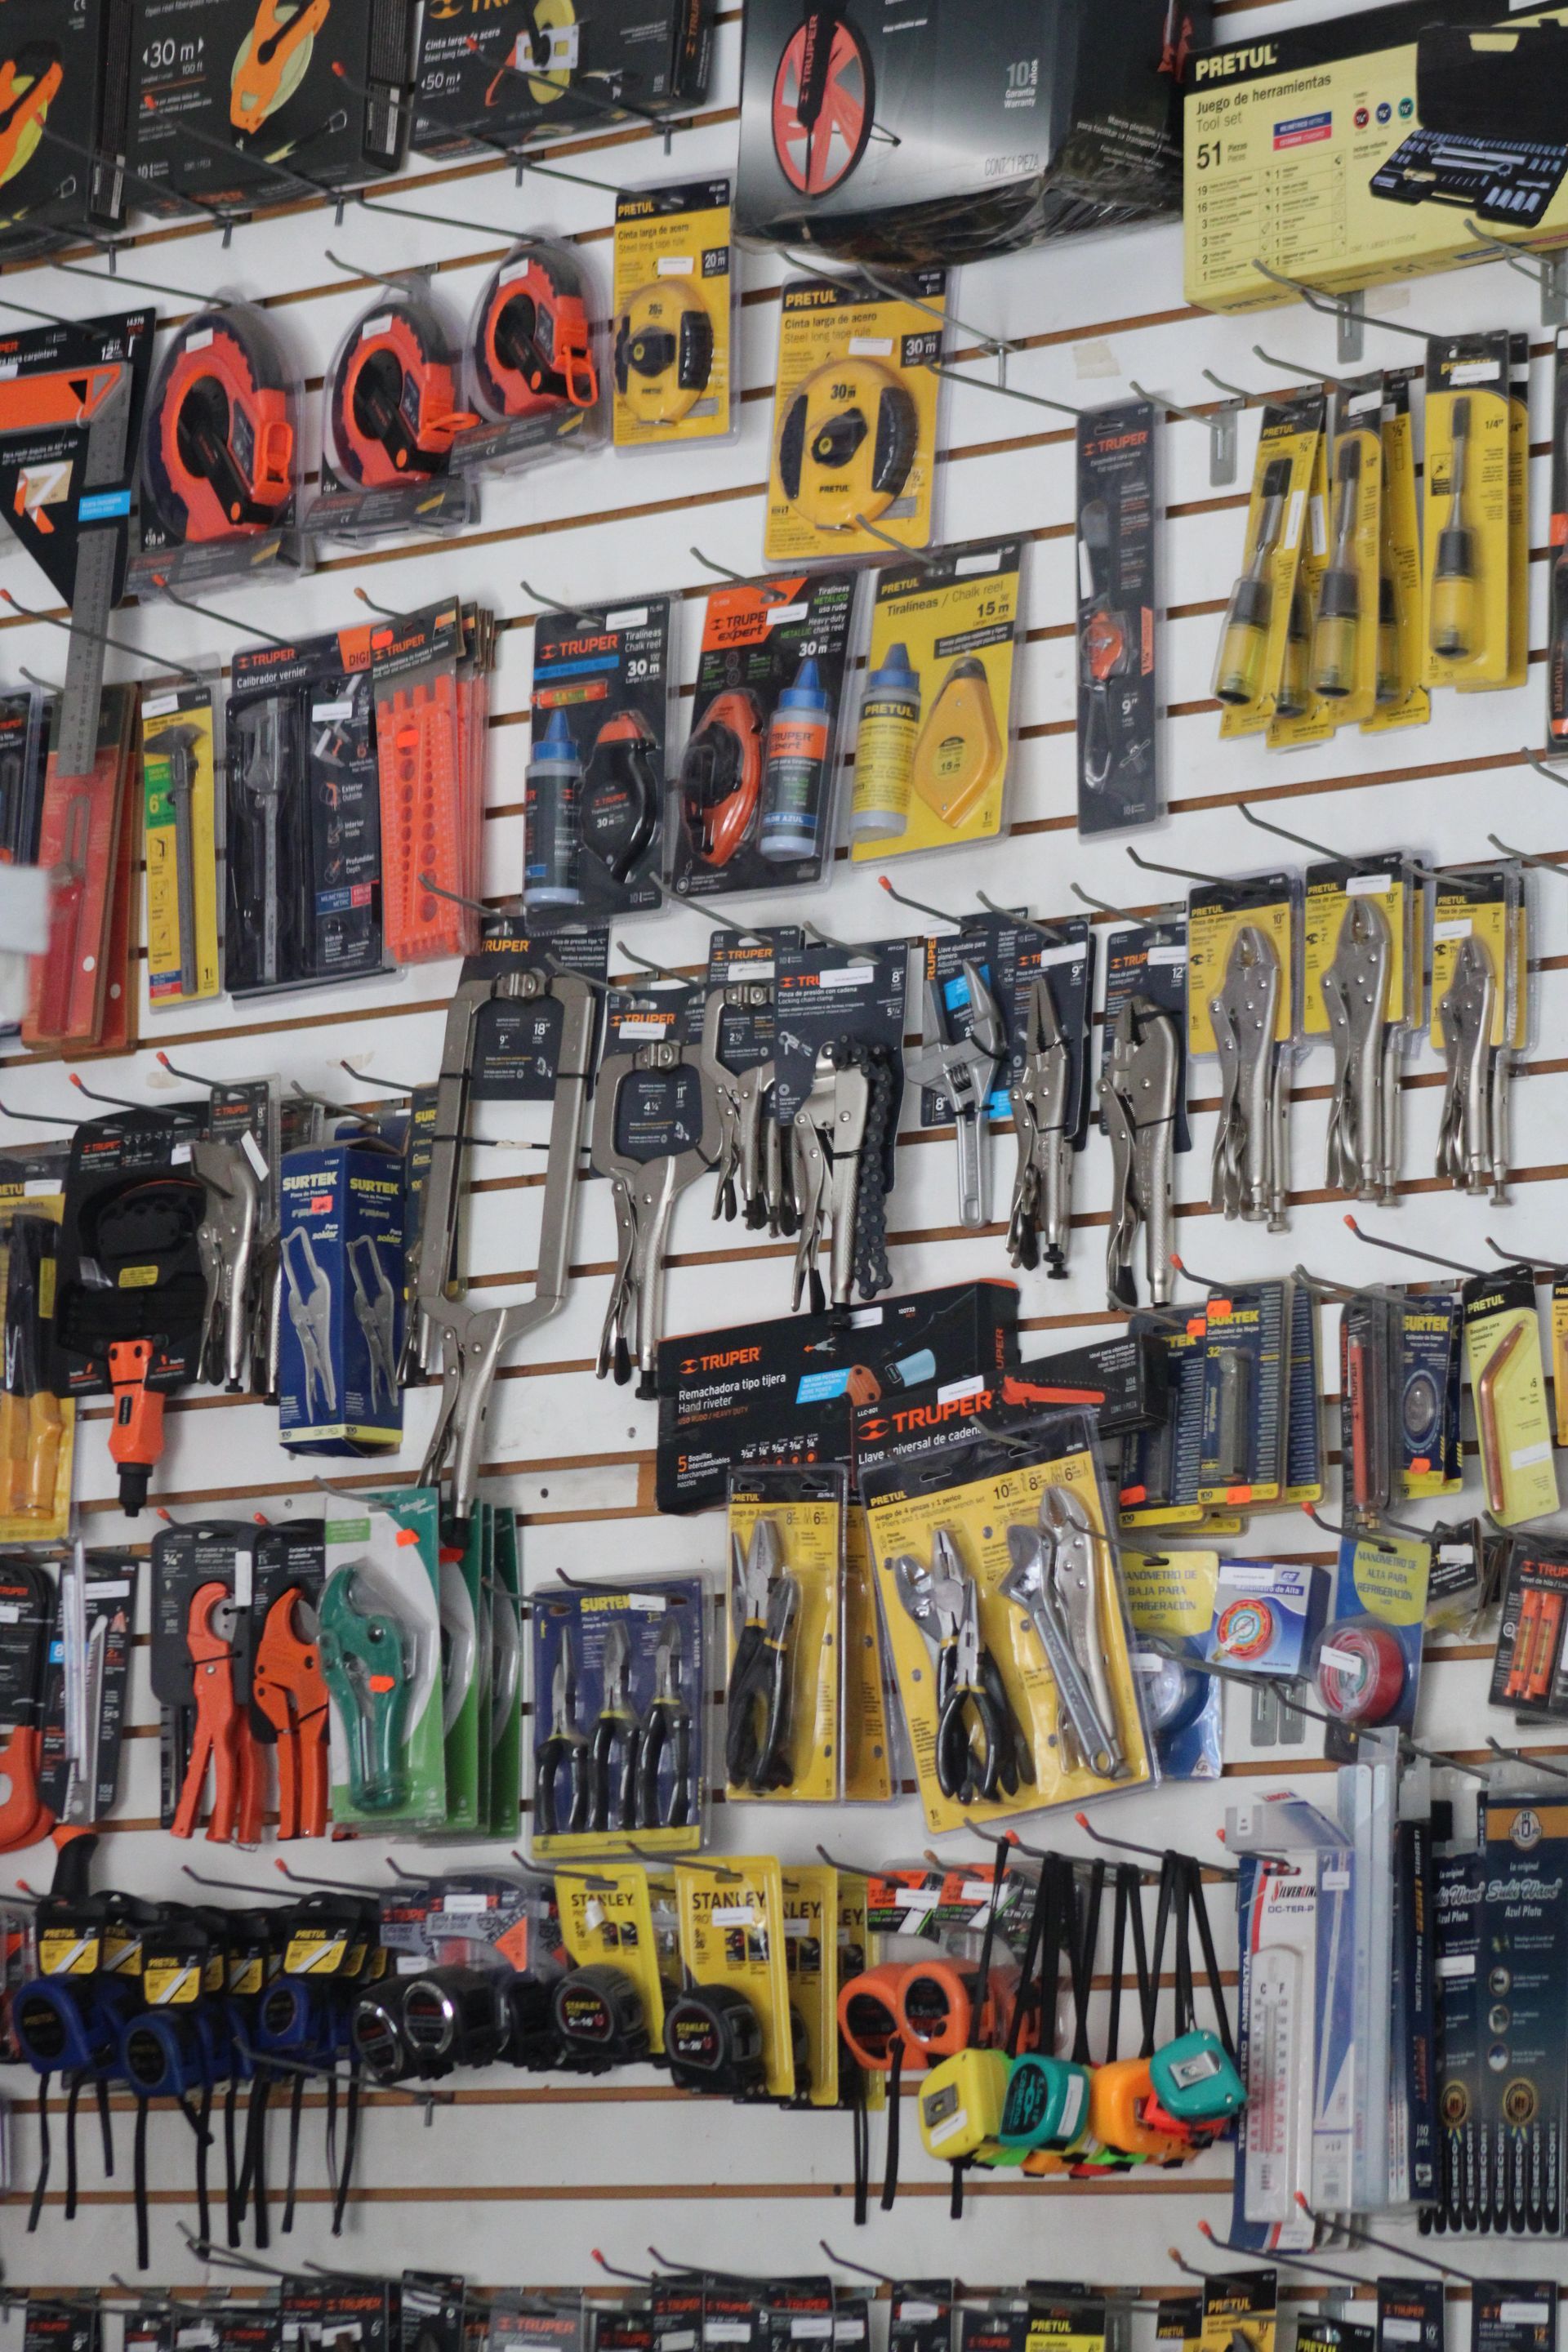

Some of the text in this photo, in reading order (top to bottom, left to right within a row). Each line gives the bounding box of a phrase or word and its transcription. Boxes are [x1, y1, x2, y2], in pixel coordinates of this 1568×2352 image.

[149, 38, 194, 68] 30 m
[803, 15, 818, 75] TRUPER
[1195, 43, 1277, 82] PRETUL
[426, 72, 444, 91] 50
[1196, 74, 1332, 116] Juego de herramientas
[1196, 111, 1243, 133] Tool set
[1196, 140, 1222, 171] 51
[617, 200, 655, 217] PRETUL
[618, 223, 689, 240] Cinta larga de acero
[705, 252, 726, 269] 20 m
[785, 289, 837, 308] PRETUL
[785, 312, 877, 330] Cinta larga de acero
[906, 338, 936, 356] 30 m
[831, 384, 847, 399] 30
[1262, 424, 1294, 439] PRETUL
[1098, 430, 1149, 453] TRUPER
[881, 577, 920, 595] PRETUL
[887, 581, 1004, 617] Tiralíneas Chalk reel
[977, 600, 1009, 618] 15 m
[625, 629, 662, 640] Tiralíneas
[718, 625, 764, 642] expert
[385, 634, 425, 658] TRUPER
[559, 634, 619, 657] TRUPER
[625, 639, 662, 653] Chalk reel
[799, 641, 827, 657] 30 m
[251, 648, 296, 666] TRUPER
[349, 651, 369, 666] DIGI
[627, 659, 660, 677] 30 m
[237, 666, 308, 690] Calibrador vernier
[865, 702, 914, 718] PRETUL
[1307, 883, 1339, 895] PRETUL
[1437, 896, 1468, 905] PRETUL
[1191, 905, 1224, 917] PRETUL
[728, 948, 773, 960] TRUPER
[283, 1171, 338, 1192] SURTEK
[350, 1178, 399, 1195] SURTEK
[1467, 1294, 1505, 1314] PRETUL
[1207, 1310, 1260, 1327] SURTEK
[1402, 1316, 1450, 1332] SURTEK
[700, 1347, 760, 1371] TRUPER
[679, 1374, 786, 1401] Remachadora tipo tijera
[679, 1395, 733, 1414] Hand riveter
[892, 1389, 993, 1433] TRUPER
[858, 1433, 947, 1466] Llave de
[678, 1455, 688, 1473] 5
[870, 1490, 907, 1507] PRETUL
[875, 1513, 894, 1524] Juego
[910, 1503, 929, 1515] pinzas
[1408, 1558, 1417, 1570] DE
[1185, 1570, 1197, 1580] DE
[1367, 1568, 1408, 1584] ALTA PARA
[1128, 1584, 1187, 1597] BAJA PARA
[1284, 1585, 1300, 1595] Alta
[692, 1891, 766, 1910] STANLEY
[1504, 1904, 1542, 1918] Azul Plata
